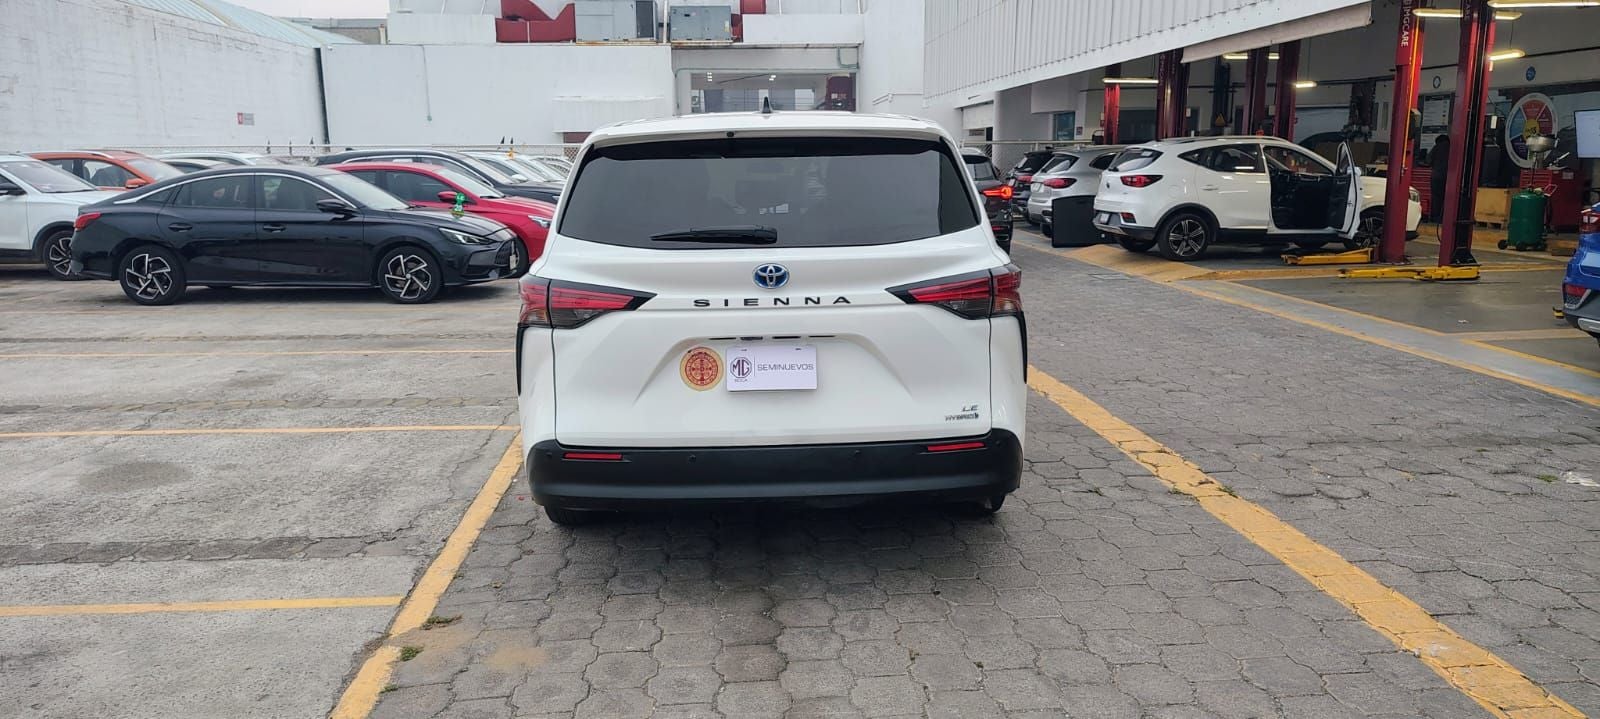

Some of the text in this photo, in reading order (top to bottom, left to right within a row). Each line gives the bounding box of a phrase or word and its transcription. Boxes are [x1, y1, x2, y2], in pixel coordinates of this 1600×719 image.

[693, 296, 852, 307] SIENNA
[731, 358, 751, 378] MG
[757, 363, 814, 372] SEMINUEVOS
